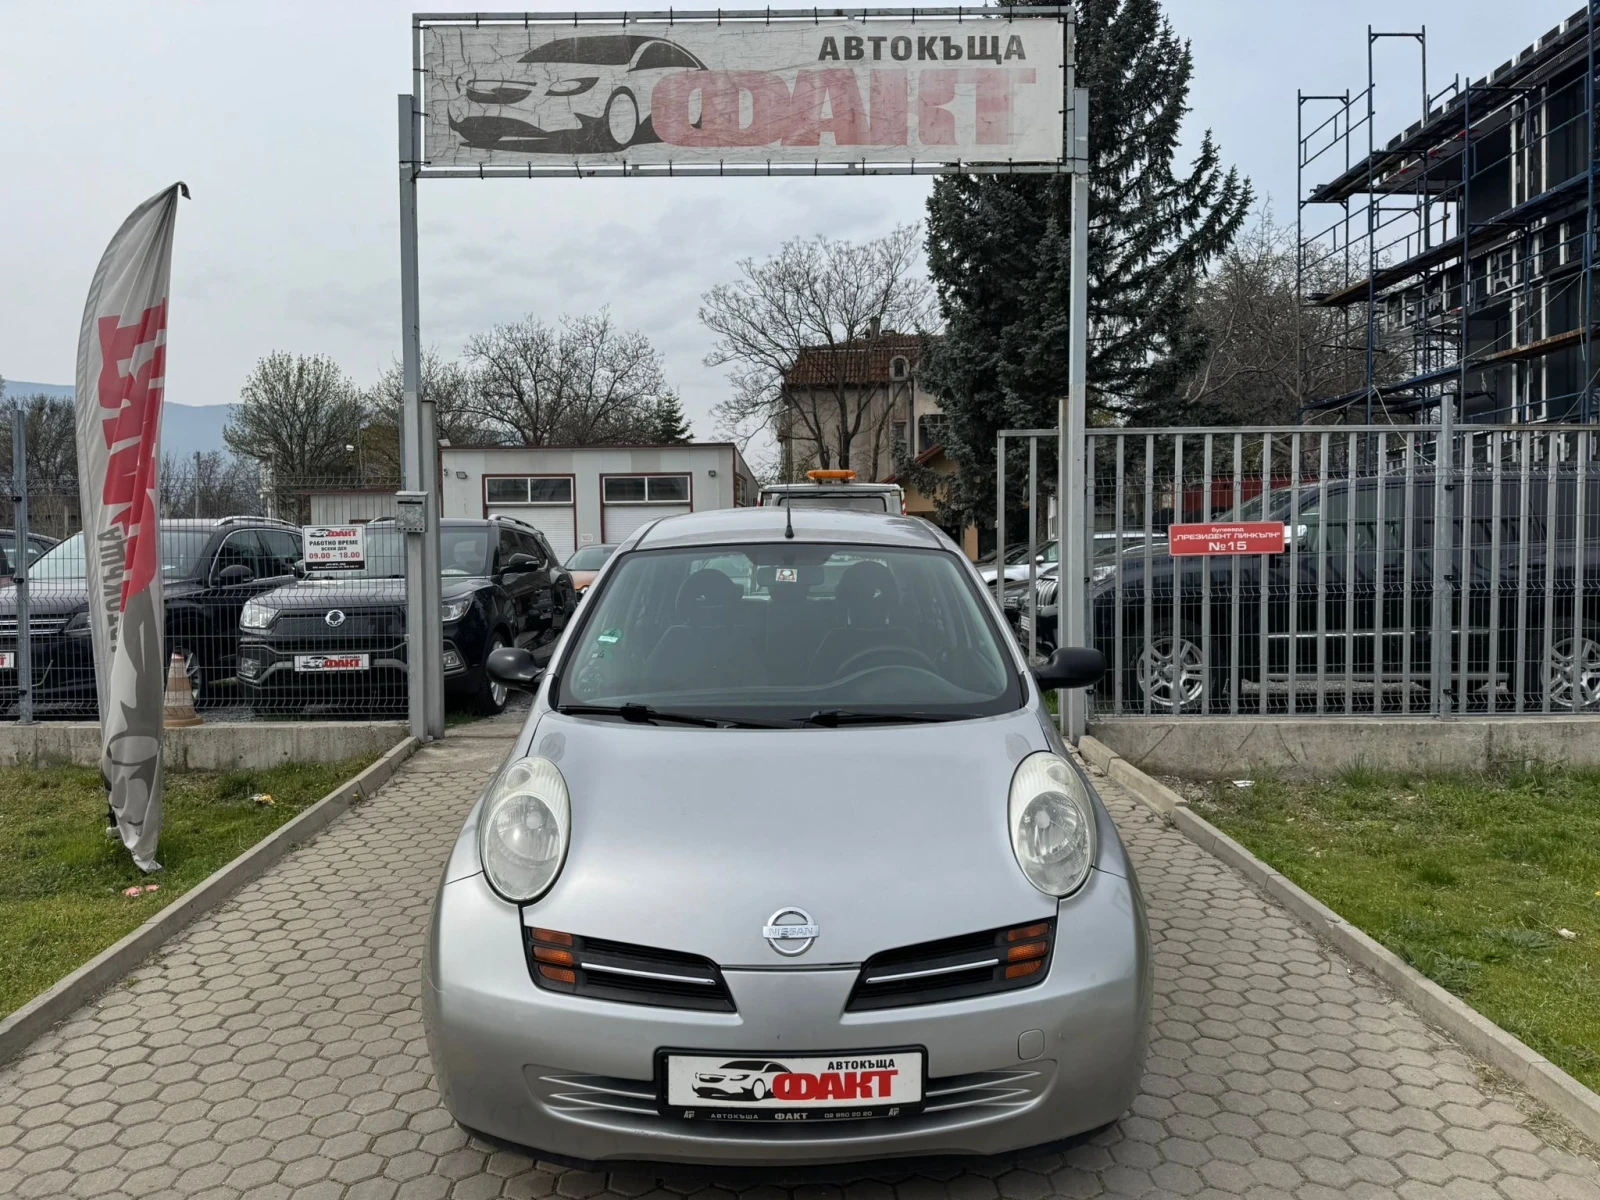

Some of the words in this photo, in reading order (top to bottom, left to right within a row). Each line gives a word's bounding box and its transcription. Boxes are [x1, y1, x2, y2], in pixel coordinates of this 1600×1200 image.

[818, 35, 1026, 64] АВТОКЪЩА
[651, 67, 1036, 147] ФАКТ
[768, 927, 813, 937] NISSAN
[827, 1058, 895, 1071] АВТОКЪЩА
[772, 1069, 898, 1101] ФАКТ
[774, 1112, 808, 1120] ФАКТ
